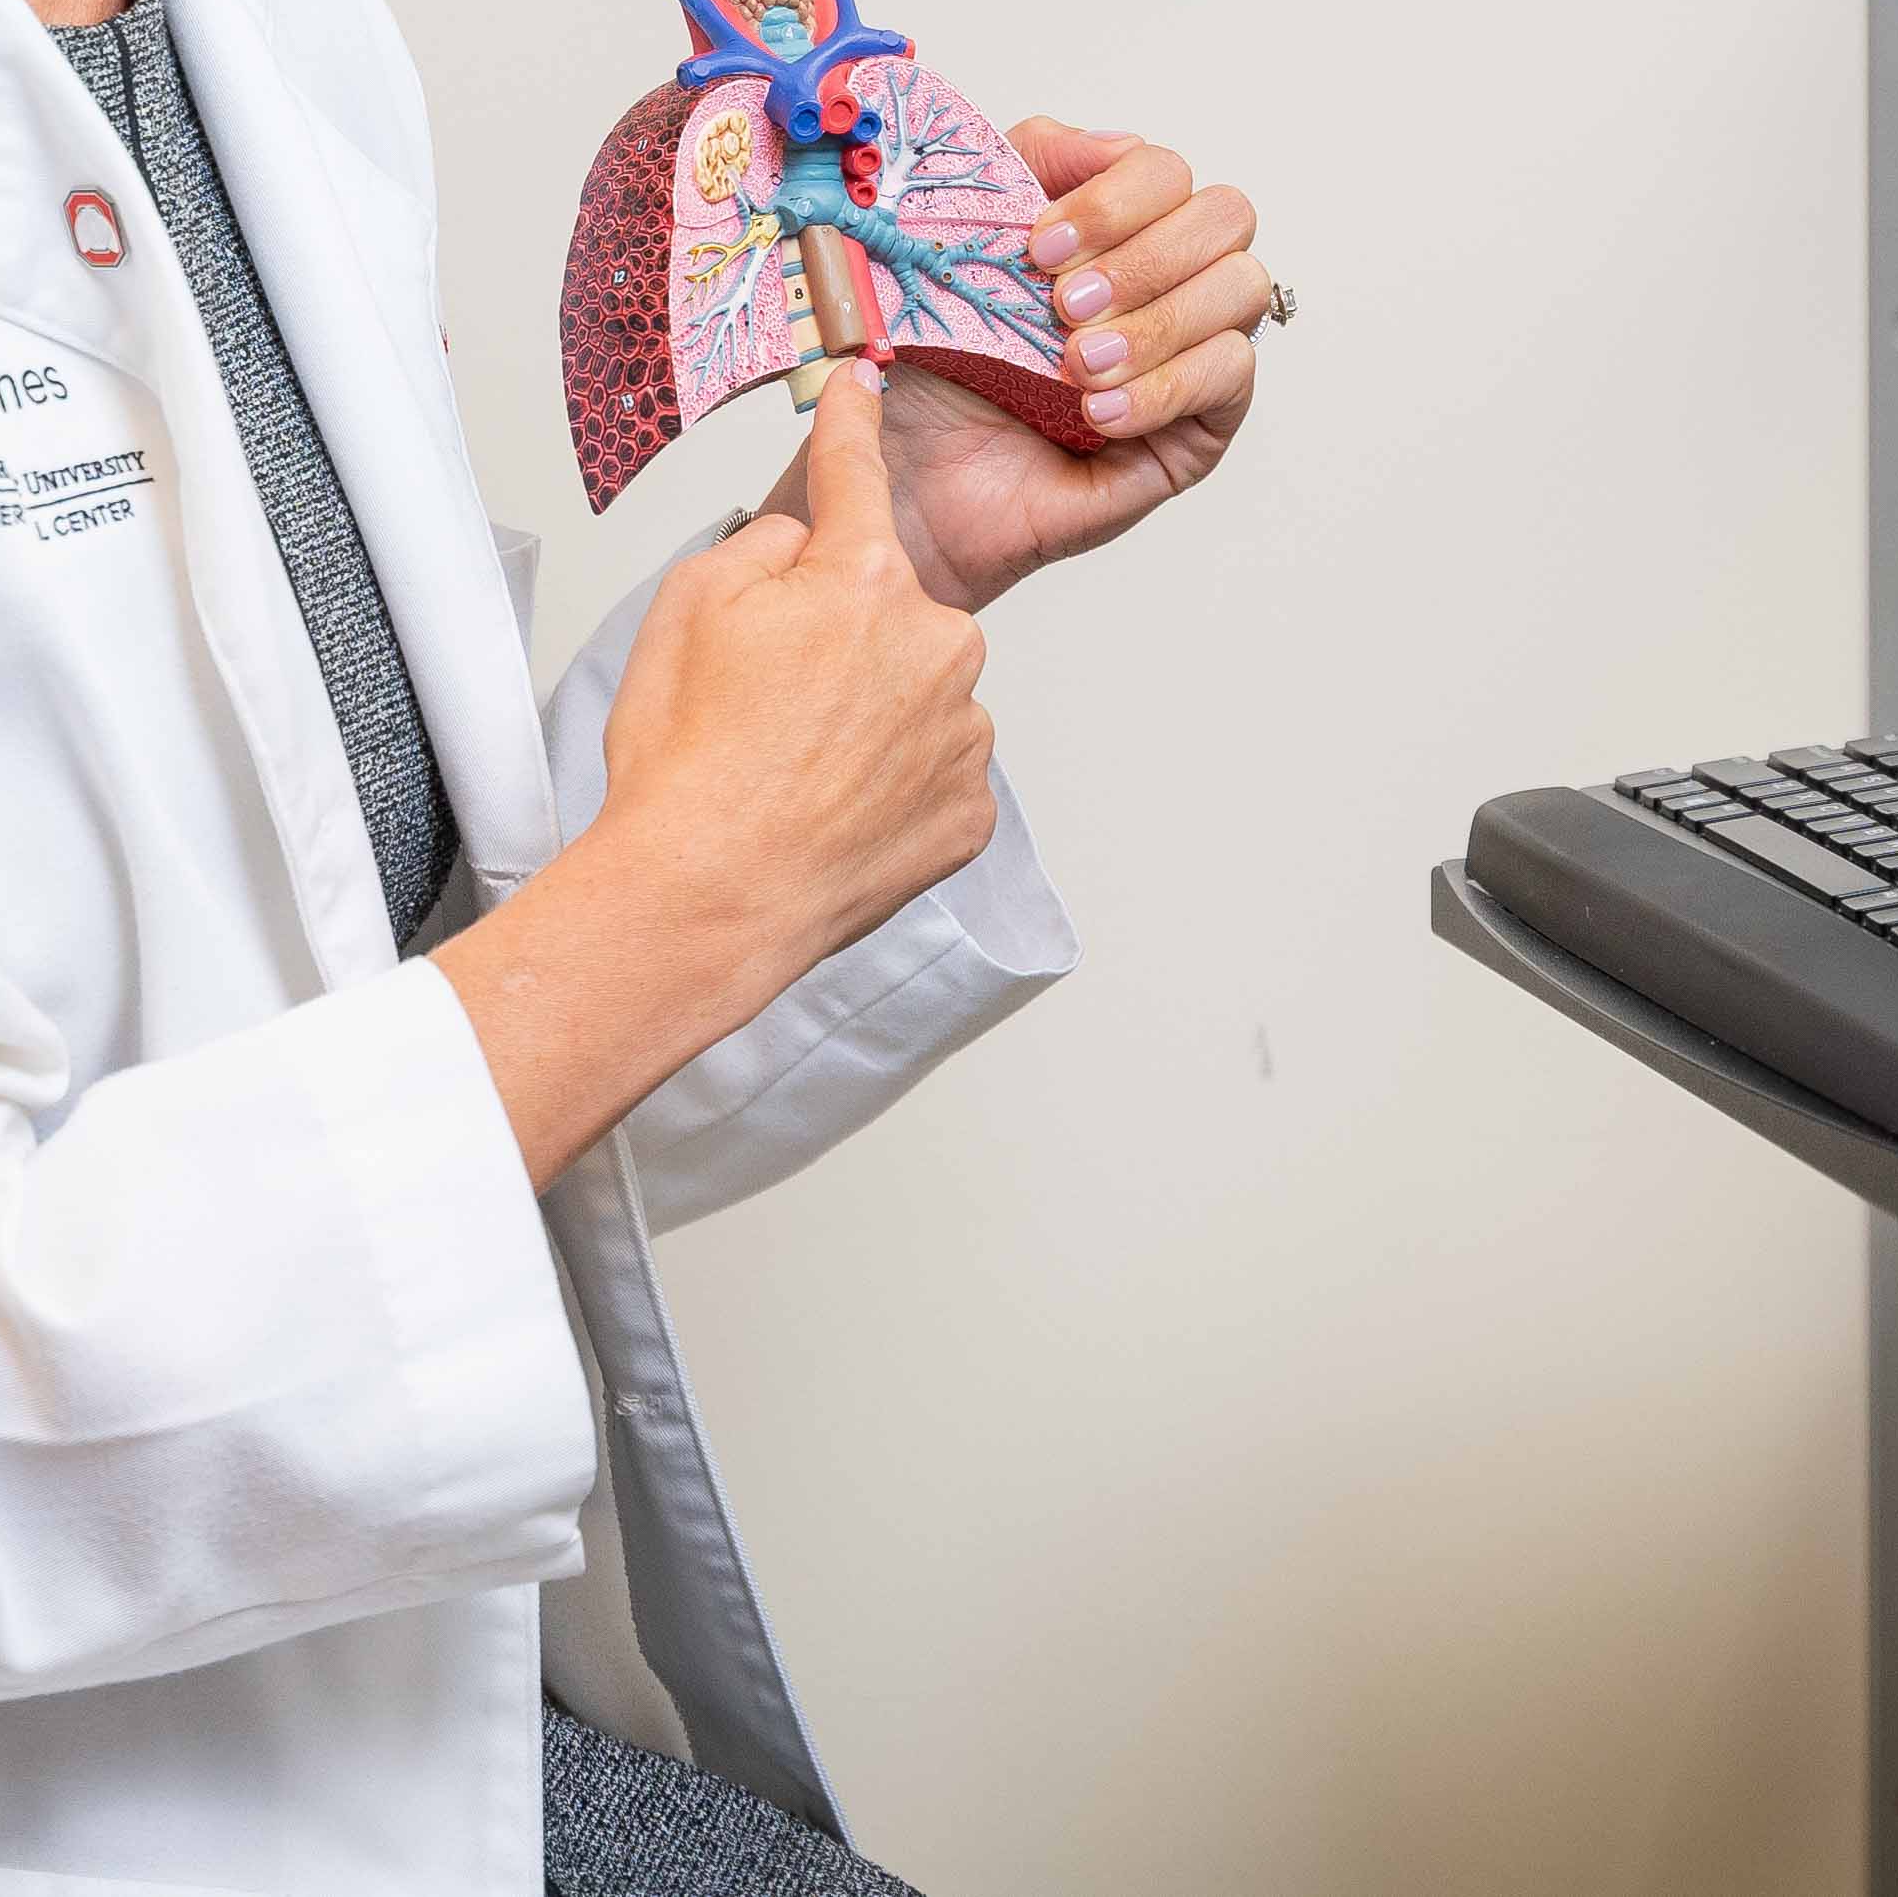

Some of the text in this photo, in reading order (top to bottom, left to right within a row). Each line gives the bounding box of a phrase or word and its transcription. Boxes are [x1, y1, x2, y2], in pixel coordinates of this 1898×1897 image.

[794, 287, 804, 300] 8
[875, 338, 890, 351] 10
[23, 450, 145, 494] UNIVERSITY
[54, 498, 135, 537] CENTER
